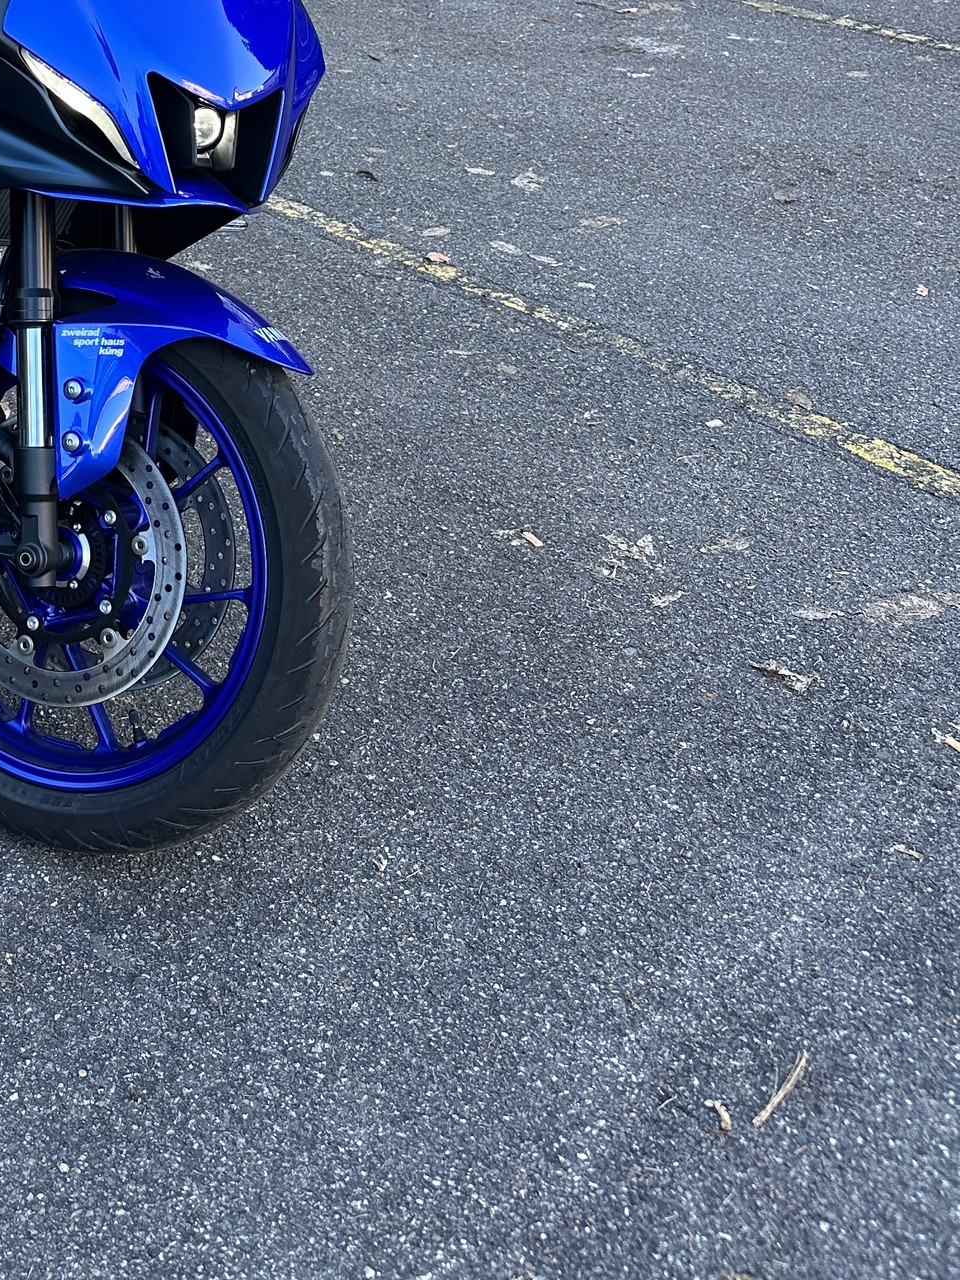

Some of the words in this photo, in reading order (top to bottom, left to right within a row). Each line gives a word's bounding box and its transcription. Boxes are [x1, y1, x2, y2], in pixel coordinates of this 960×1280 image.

[61, 328, 100, 337] zweirad
[73, 338, 99, 347] sport
[101, 337, 125, 346] haus
[99, 347, 124, 357] küng
